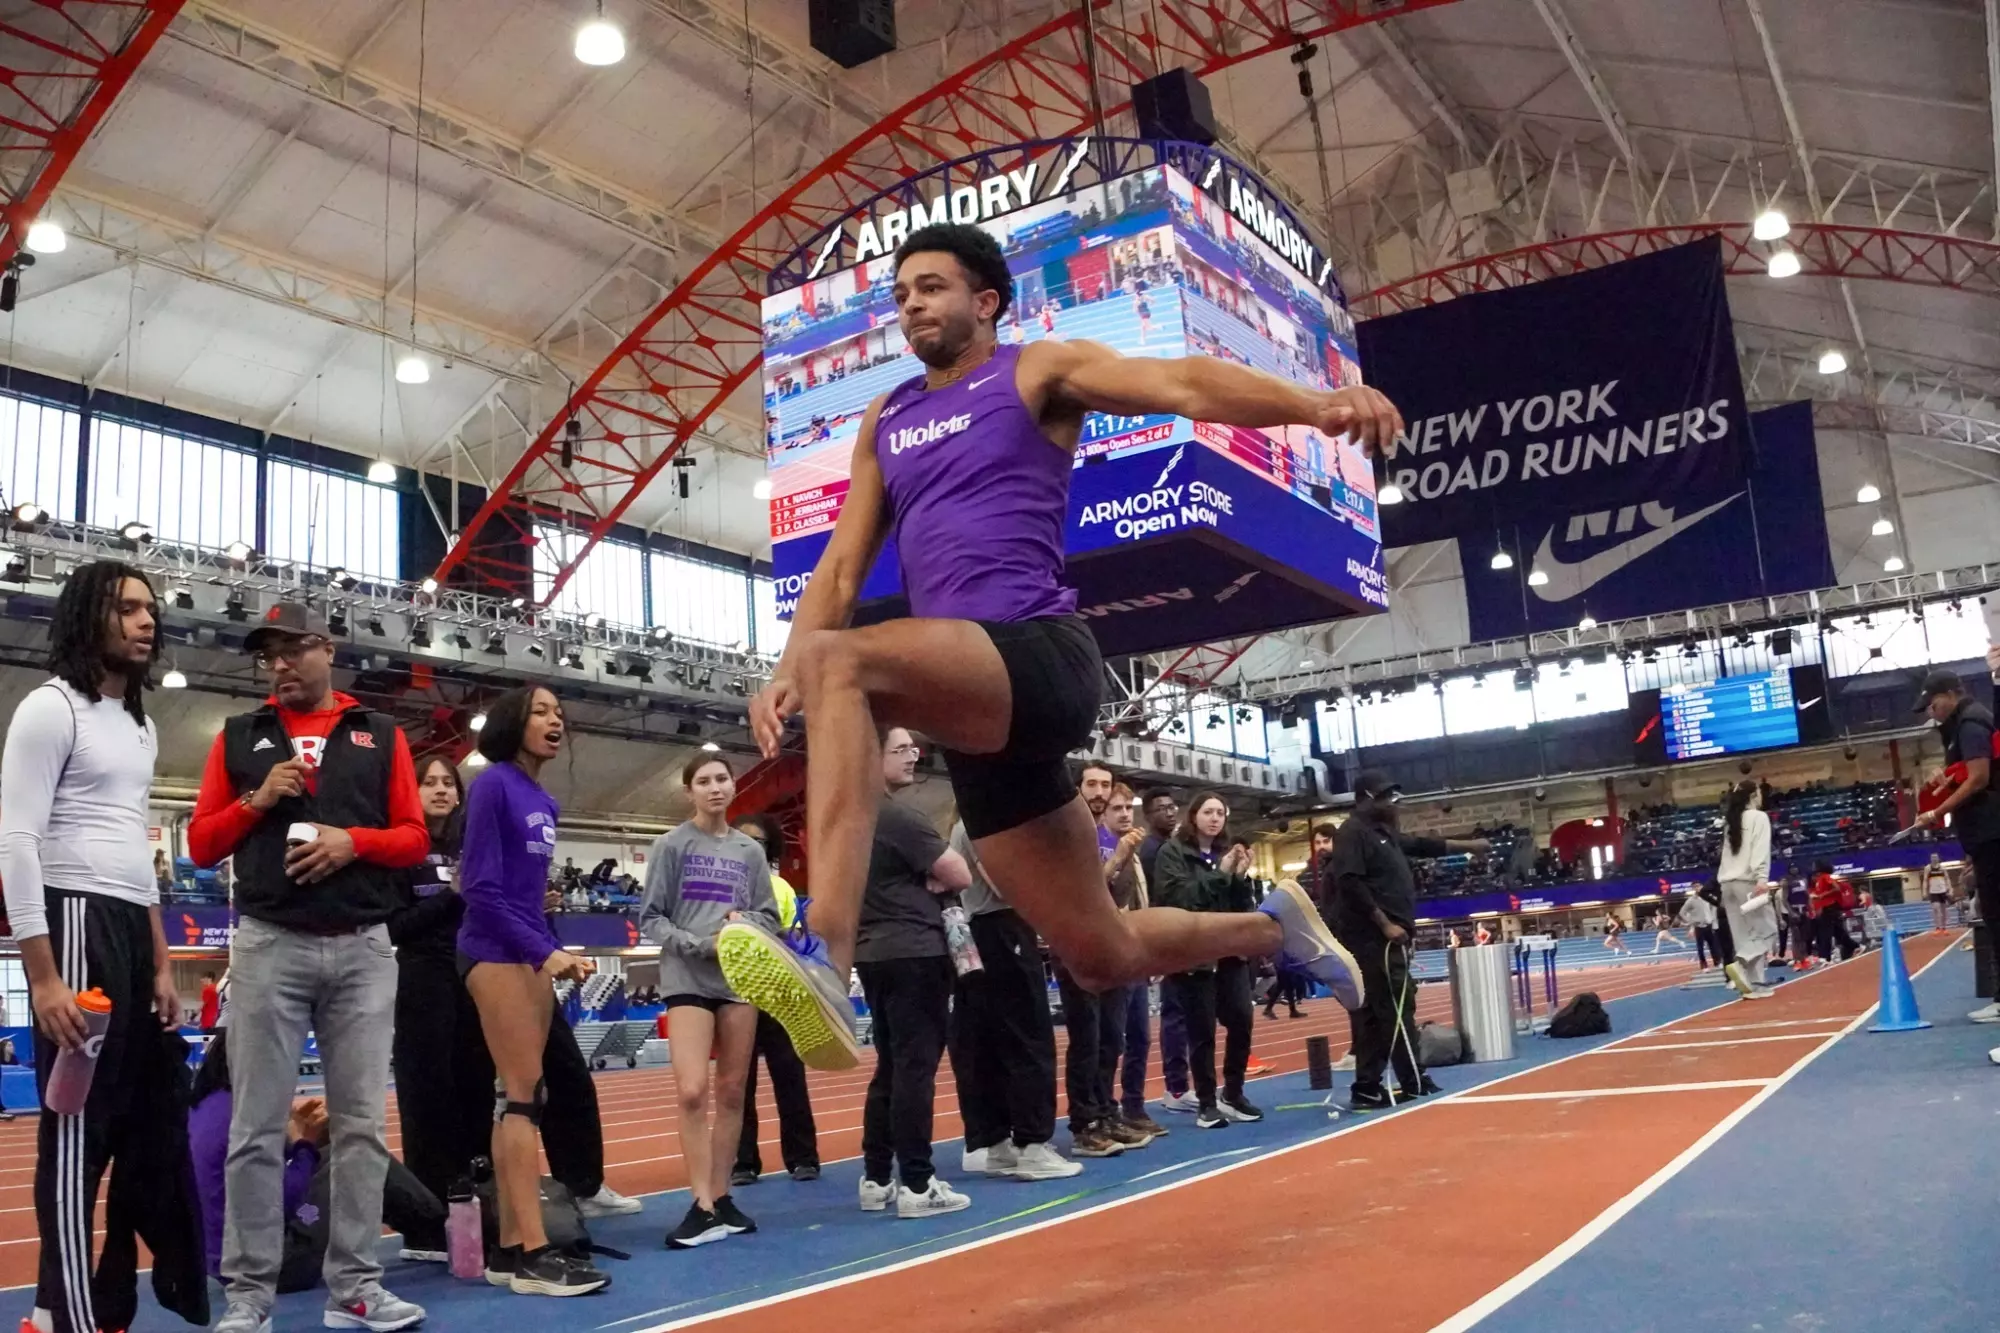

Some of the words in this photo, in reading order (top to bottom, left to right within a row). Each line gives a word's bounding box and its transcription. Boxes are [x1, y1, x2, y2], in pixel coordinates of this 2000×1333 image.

[856, 163, 1039, 262] ARMORY
[1230, 177, 1313, 277] ARMORY
[1390, 403, 1488, 460] NEW
[1497, 379, 1619, 437] YORK
[1395, 449, 1509, 502] ROAD
[1521, 399, 1729, 481] RUNNERS
[1079, 484, 1184, 528] ARMORY
[1189, 481, 1233, 515] STORE
[1114, 513, 1176, 540] Open
[1181, 504, 1217, 527] Now
[1347, 557, 1381, 588] ARMORY
